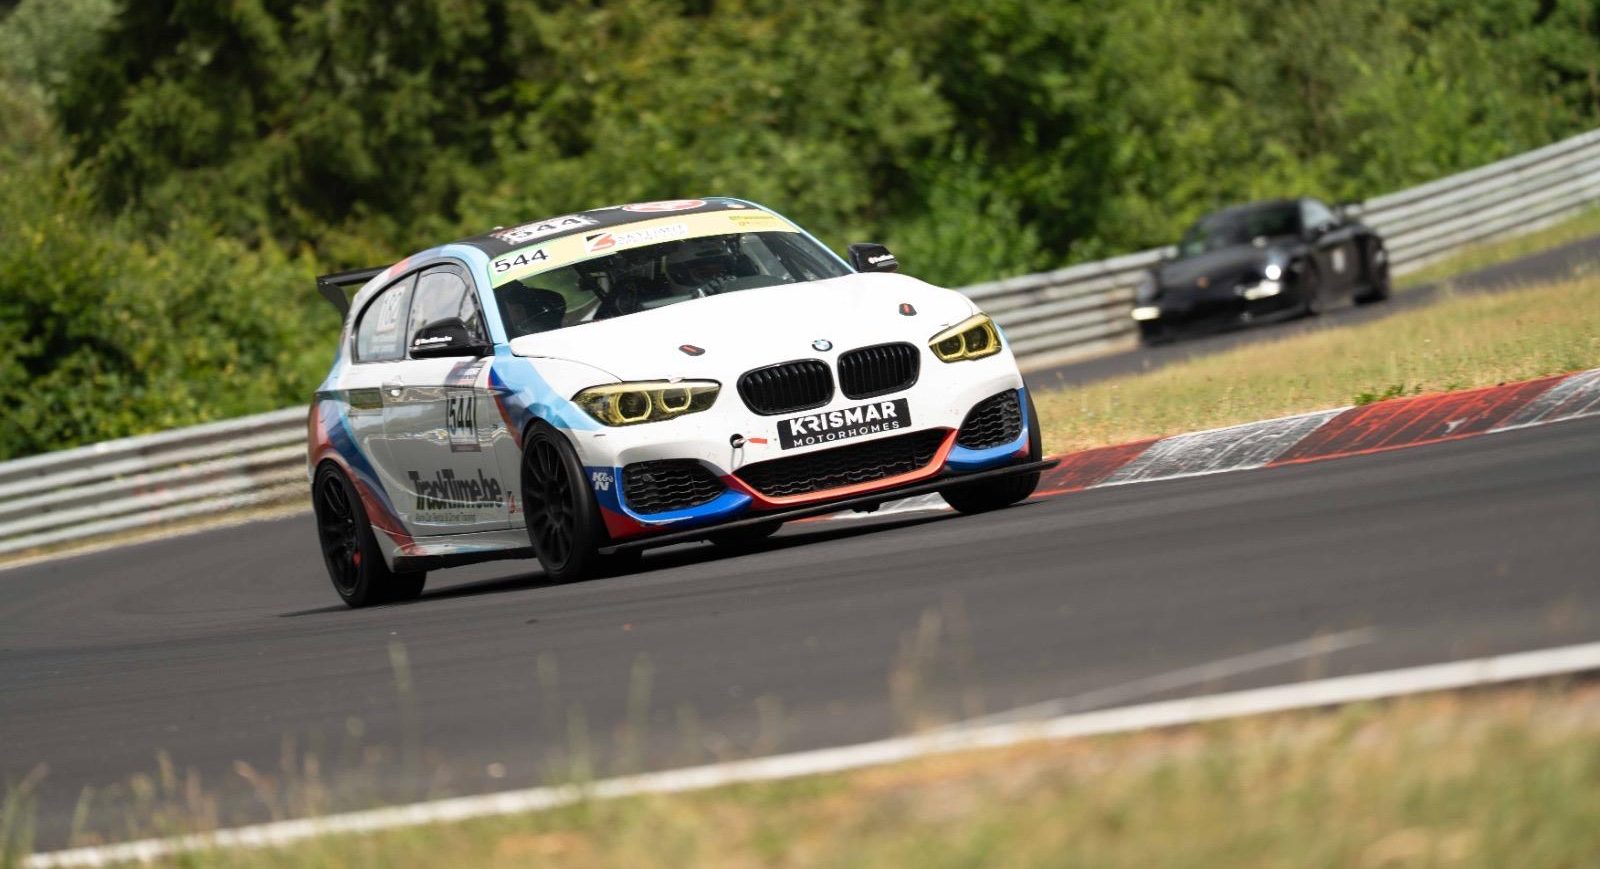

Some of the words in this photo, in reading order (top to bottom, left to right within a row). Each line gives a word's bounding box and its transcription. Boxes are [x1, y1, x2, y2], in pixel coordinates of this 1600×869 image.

[495, 249, 548, 272] 544
[448, 395, 473, 436] 544
[790, 401, 897, 436] KRISMAR
[794, 421, 899, 447] MOTORHOMES
